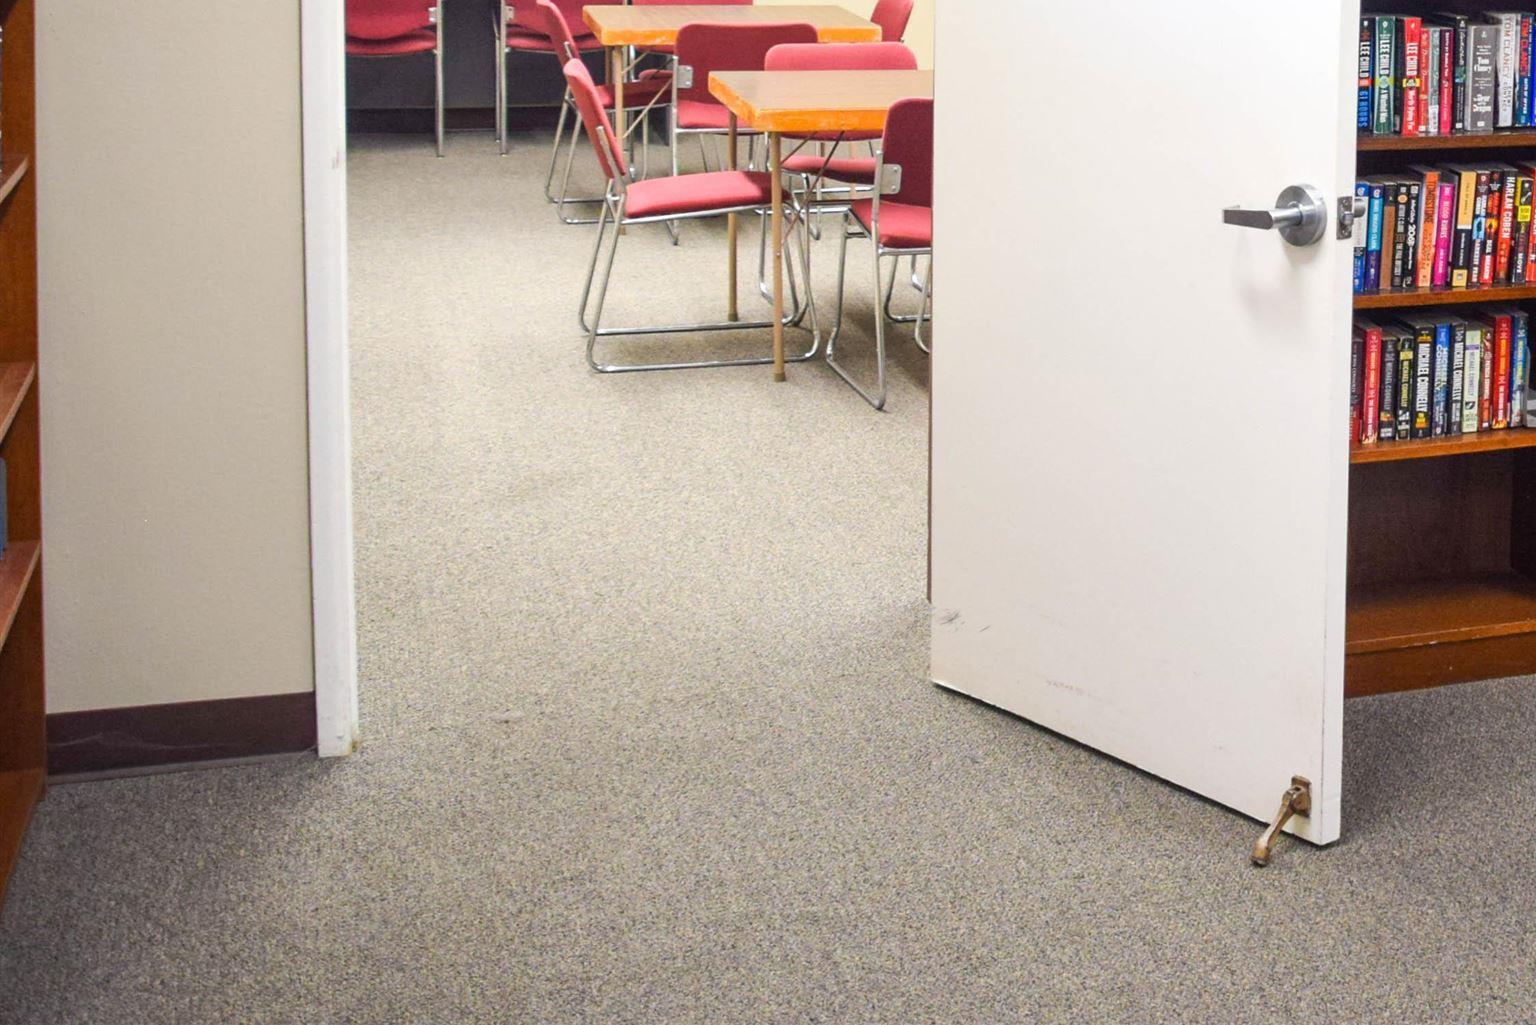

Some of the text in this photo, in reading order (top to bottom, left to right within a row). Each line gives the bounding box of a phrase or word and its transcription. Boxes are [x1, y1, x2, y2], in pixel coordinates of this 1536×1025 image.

[1504, 16, 1512, 37] TOM
[1521, 18, 1529, 37] TOM
[1361, 41, 1370, 55] LEE
[1380, 40, 1389, 53] LEE
[1408, 42, 1418, 54] LEE
[1360, 56, 1370, 77] CHILD
[1379, 54, 1389, 74] CHILD
[1407, 56, 1418, 76] CHILD
[1520, 39, 1528, 76] CLANCY
[1505, 177, 1515, 209] HARLAN
[1502, 211, 1512, 238] COBEN
[1453, 342, 1464, 369] MICHAEL
[1416, 343, 1430, 412] MICHAEL CONNELLY
[1453, 370, 1462, 400] CONNELLY
